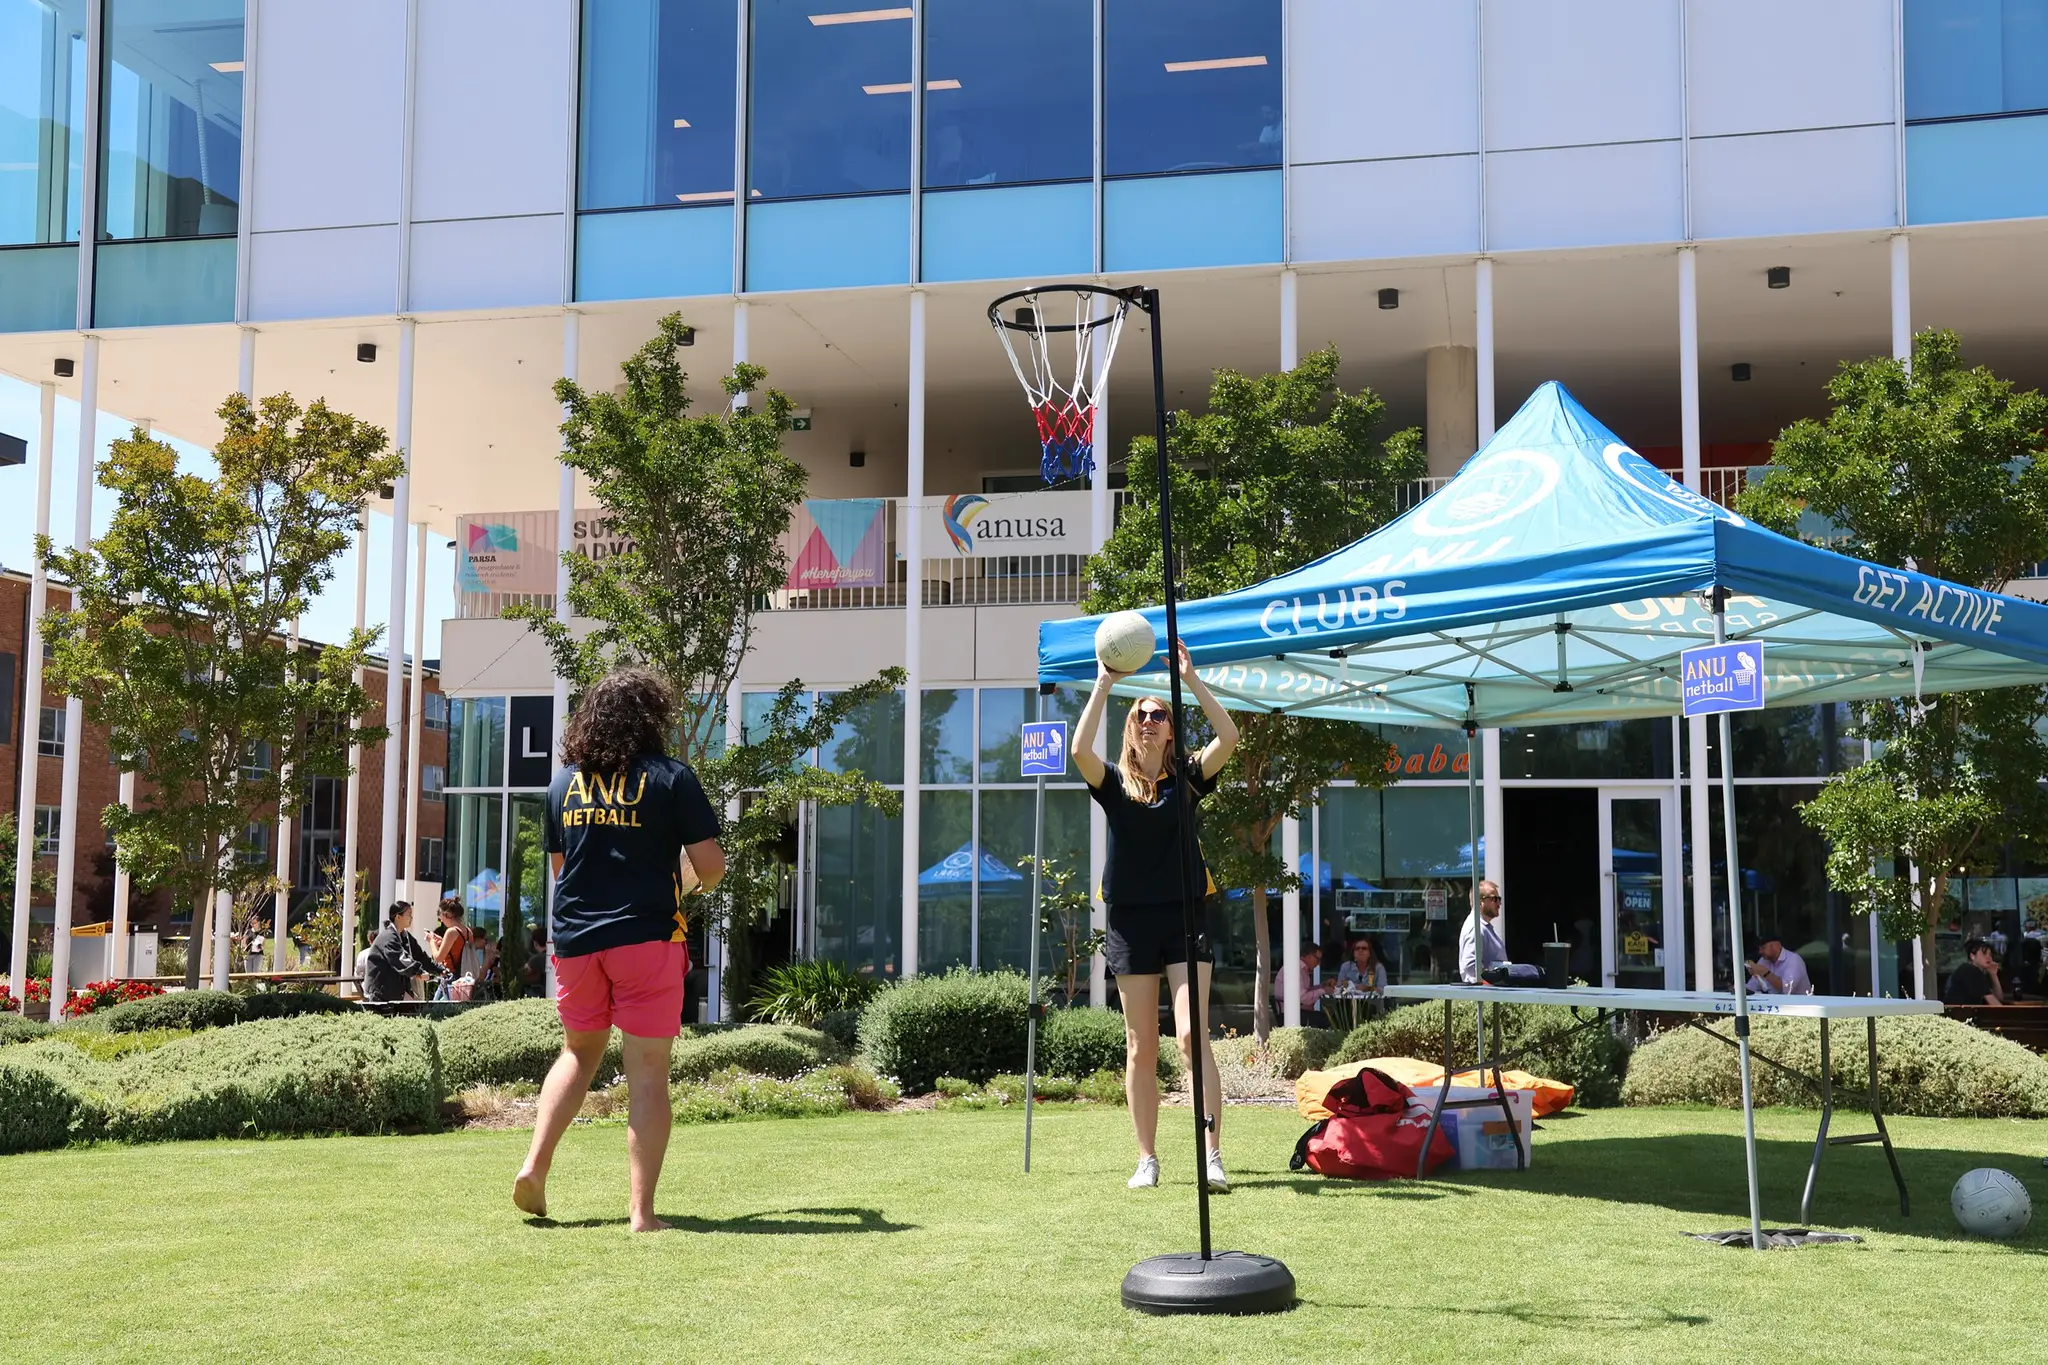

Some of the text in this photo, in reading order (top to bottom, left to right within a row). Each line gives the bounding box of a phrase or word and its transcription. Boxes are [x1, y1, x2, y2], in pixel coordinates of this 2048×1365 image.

[976, 517, 1066, 539] anusa
[468, 555, 497, 563] PARSA
[1342, 536, 1515, 579] ANU
[1260, 579, 1407, 638] CLUBS
[1853, 565, 2005, 636] GET ACTIVE
[1686, 656, 1726, 681] ANU
[1686, 676, 1733, 698] netball
[522, 726, 548, 758] L
[1023, 731, 1045, 748] ANU
[1023, 747, 1048, 761] netball
[563, 771, 648, 807] ANU
[562, 807, 642, 828] NETBALL
[1625, 896, 1650, 908] OPEN
[1715, 1003, 1734, 1011] 612
